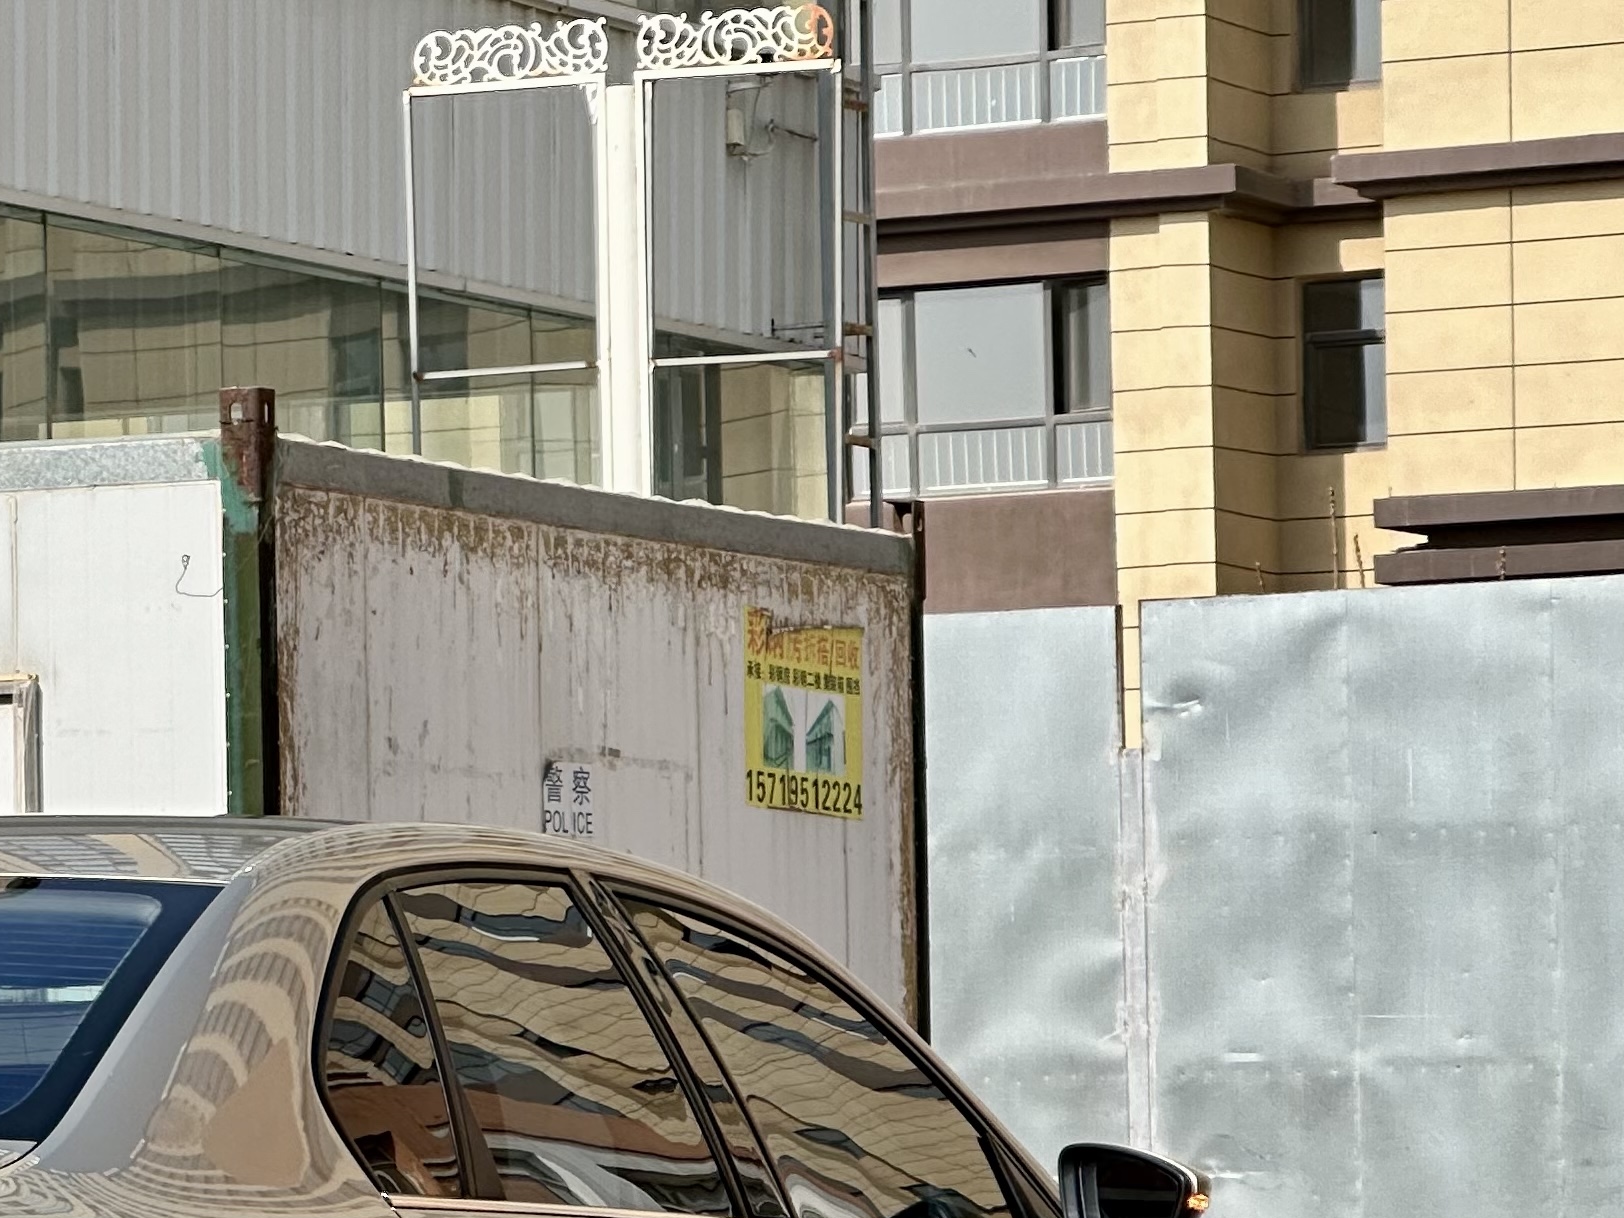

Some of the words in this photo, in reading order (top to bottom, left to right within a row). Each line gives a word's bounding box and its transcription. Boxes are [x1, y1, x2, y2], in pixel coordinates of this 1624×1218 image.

[545, 765, 592, 806] 警察
[746, 769, 864, 816] 15719512224
[543, 809, 594, 835] POLICE
